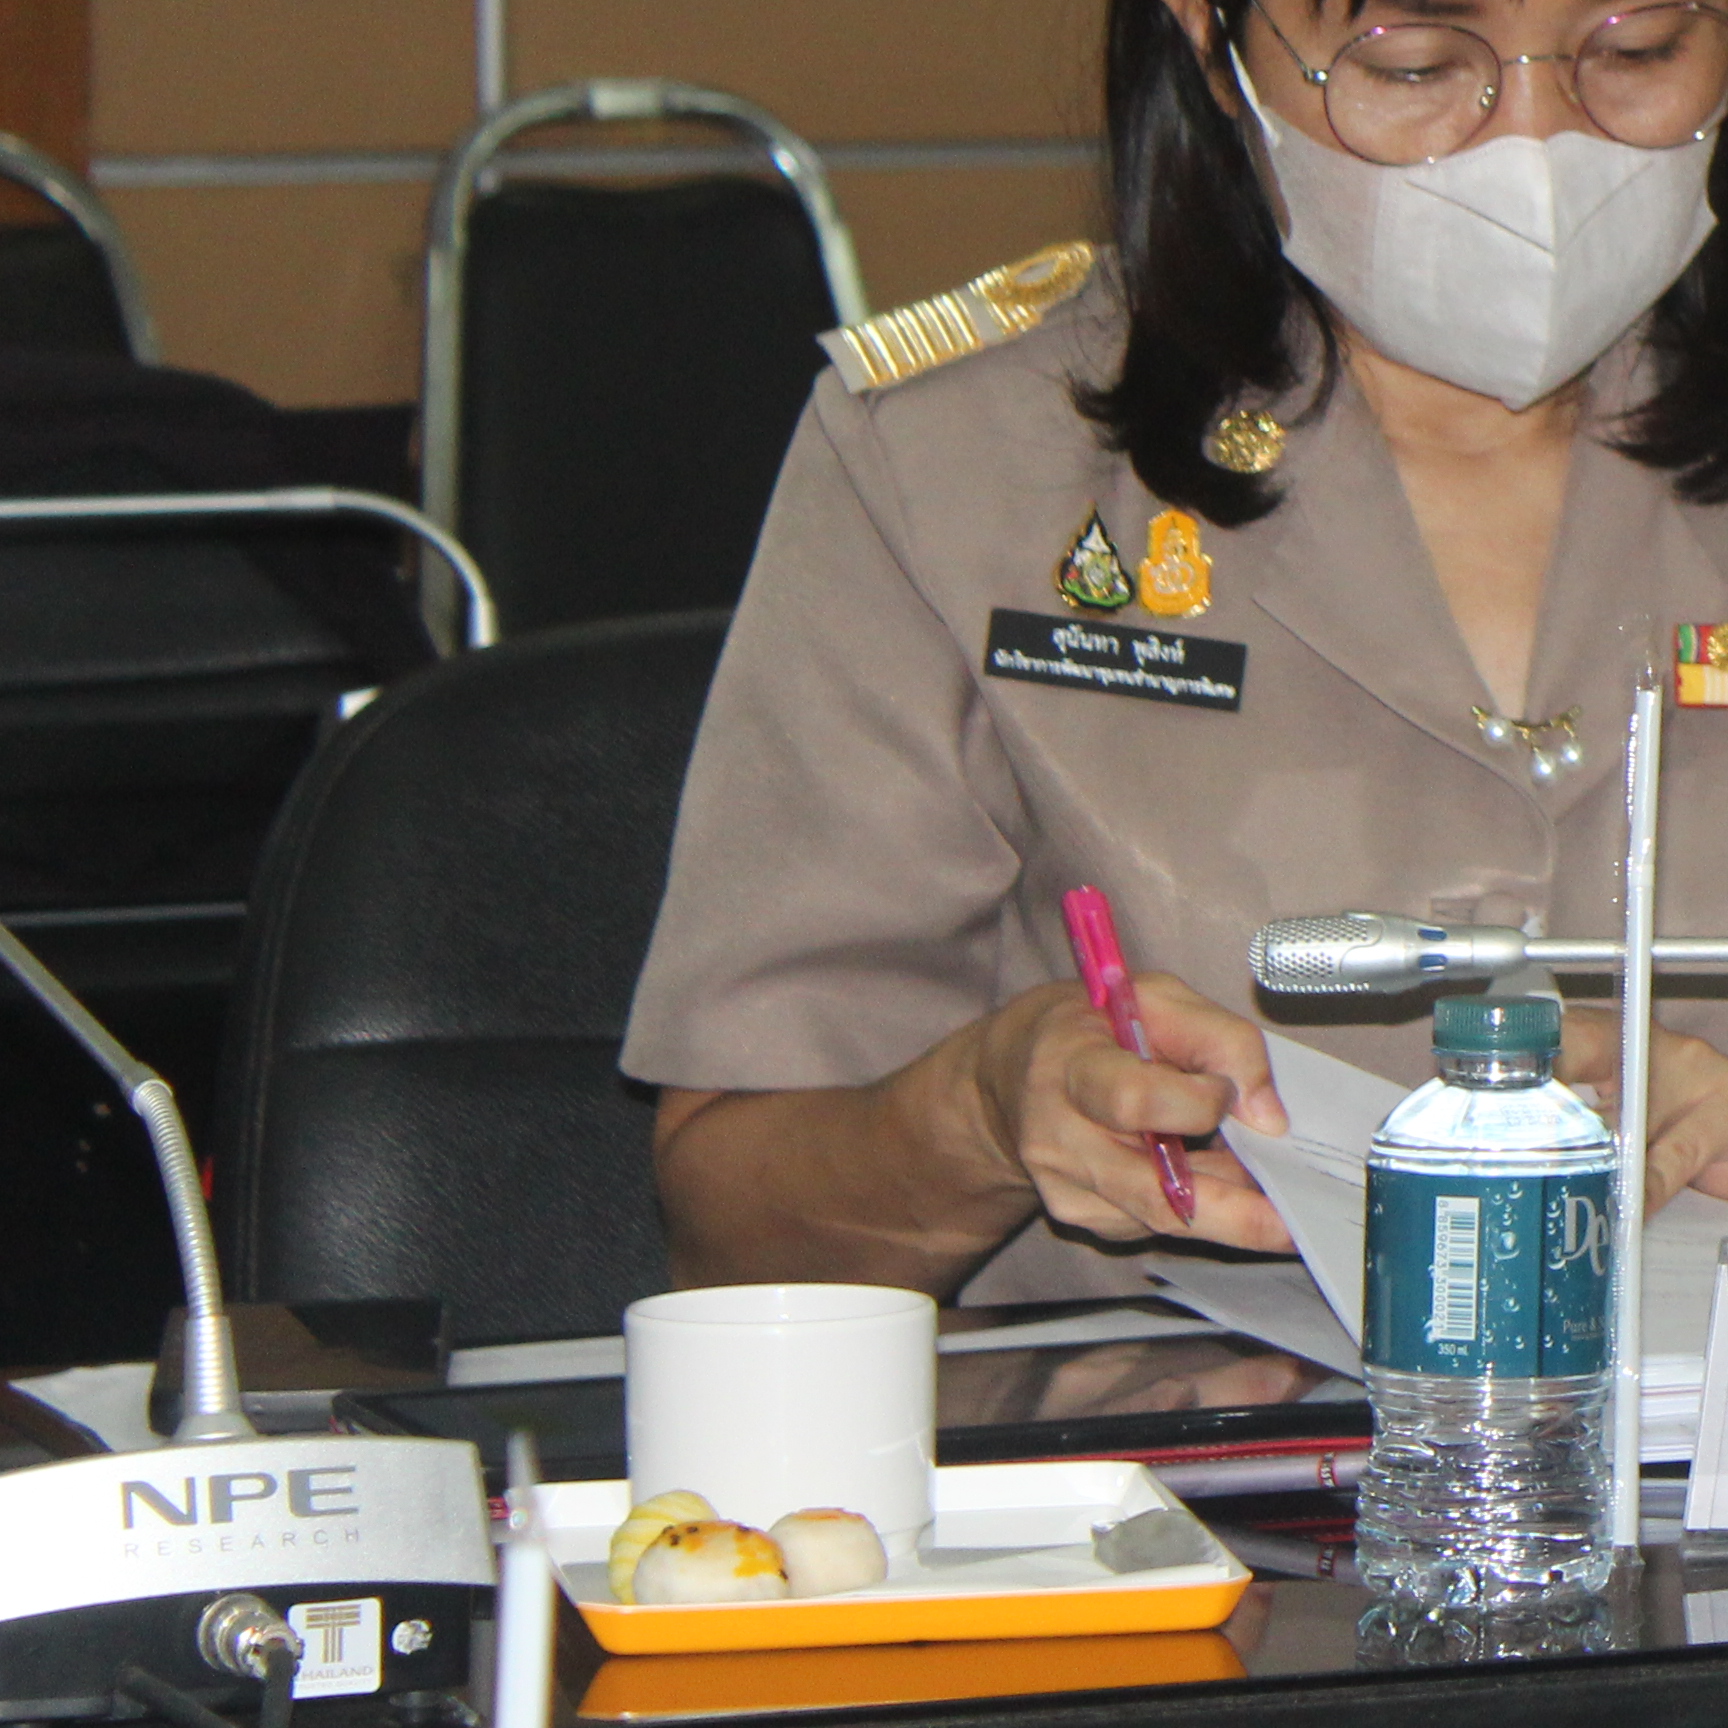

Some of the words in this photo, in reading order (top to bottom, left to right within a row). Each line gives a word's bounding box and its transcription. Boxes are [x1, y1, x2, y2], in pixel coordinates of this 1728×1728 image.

[120, 1465, 360, 1530] NPE
[124, 1528, 361, 1558] RESEARCH
[300, 1666, 374, 1681] HAILAND
